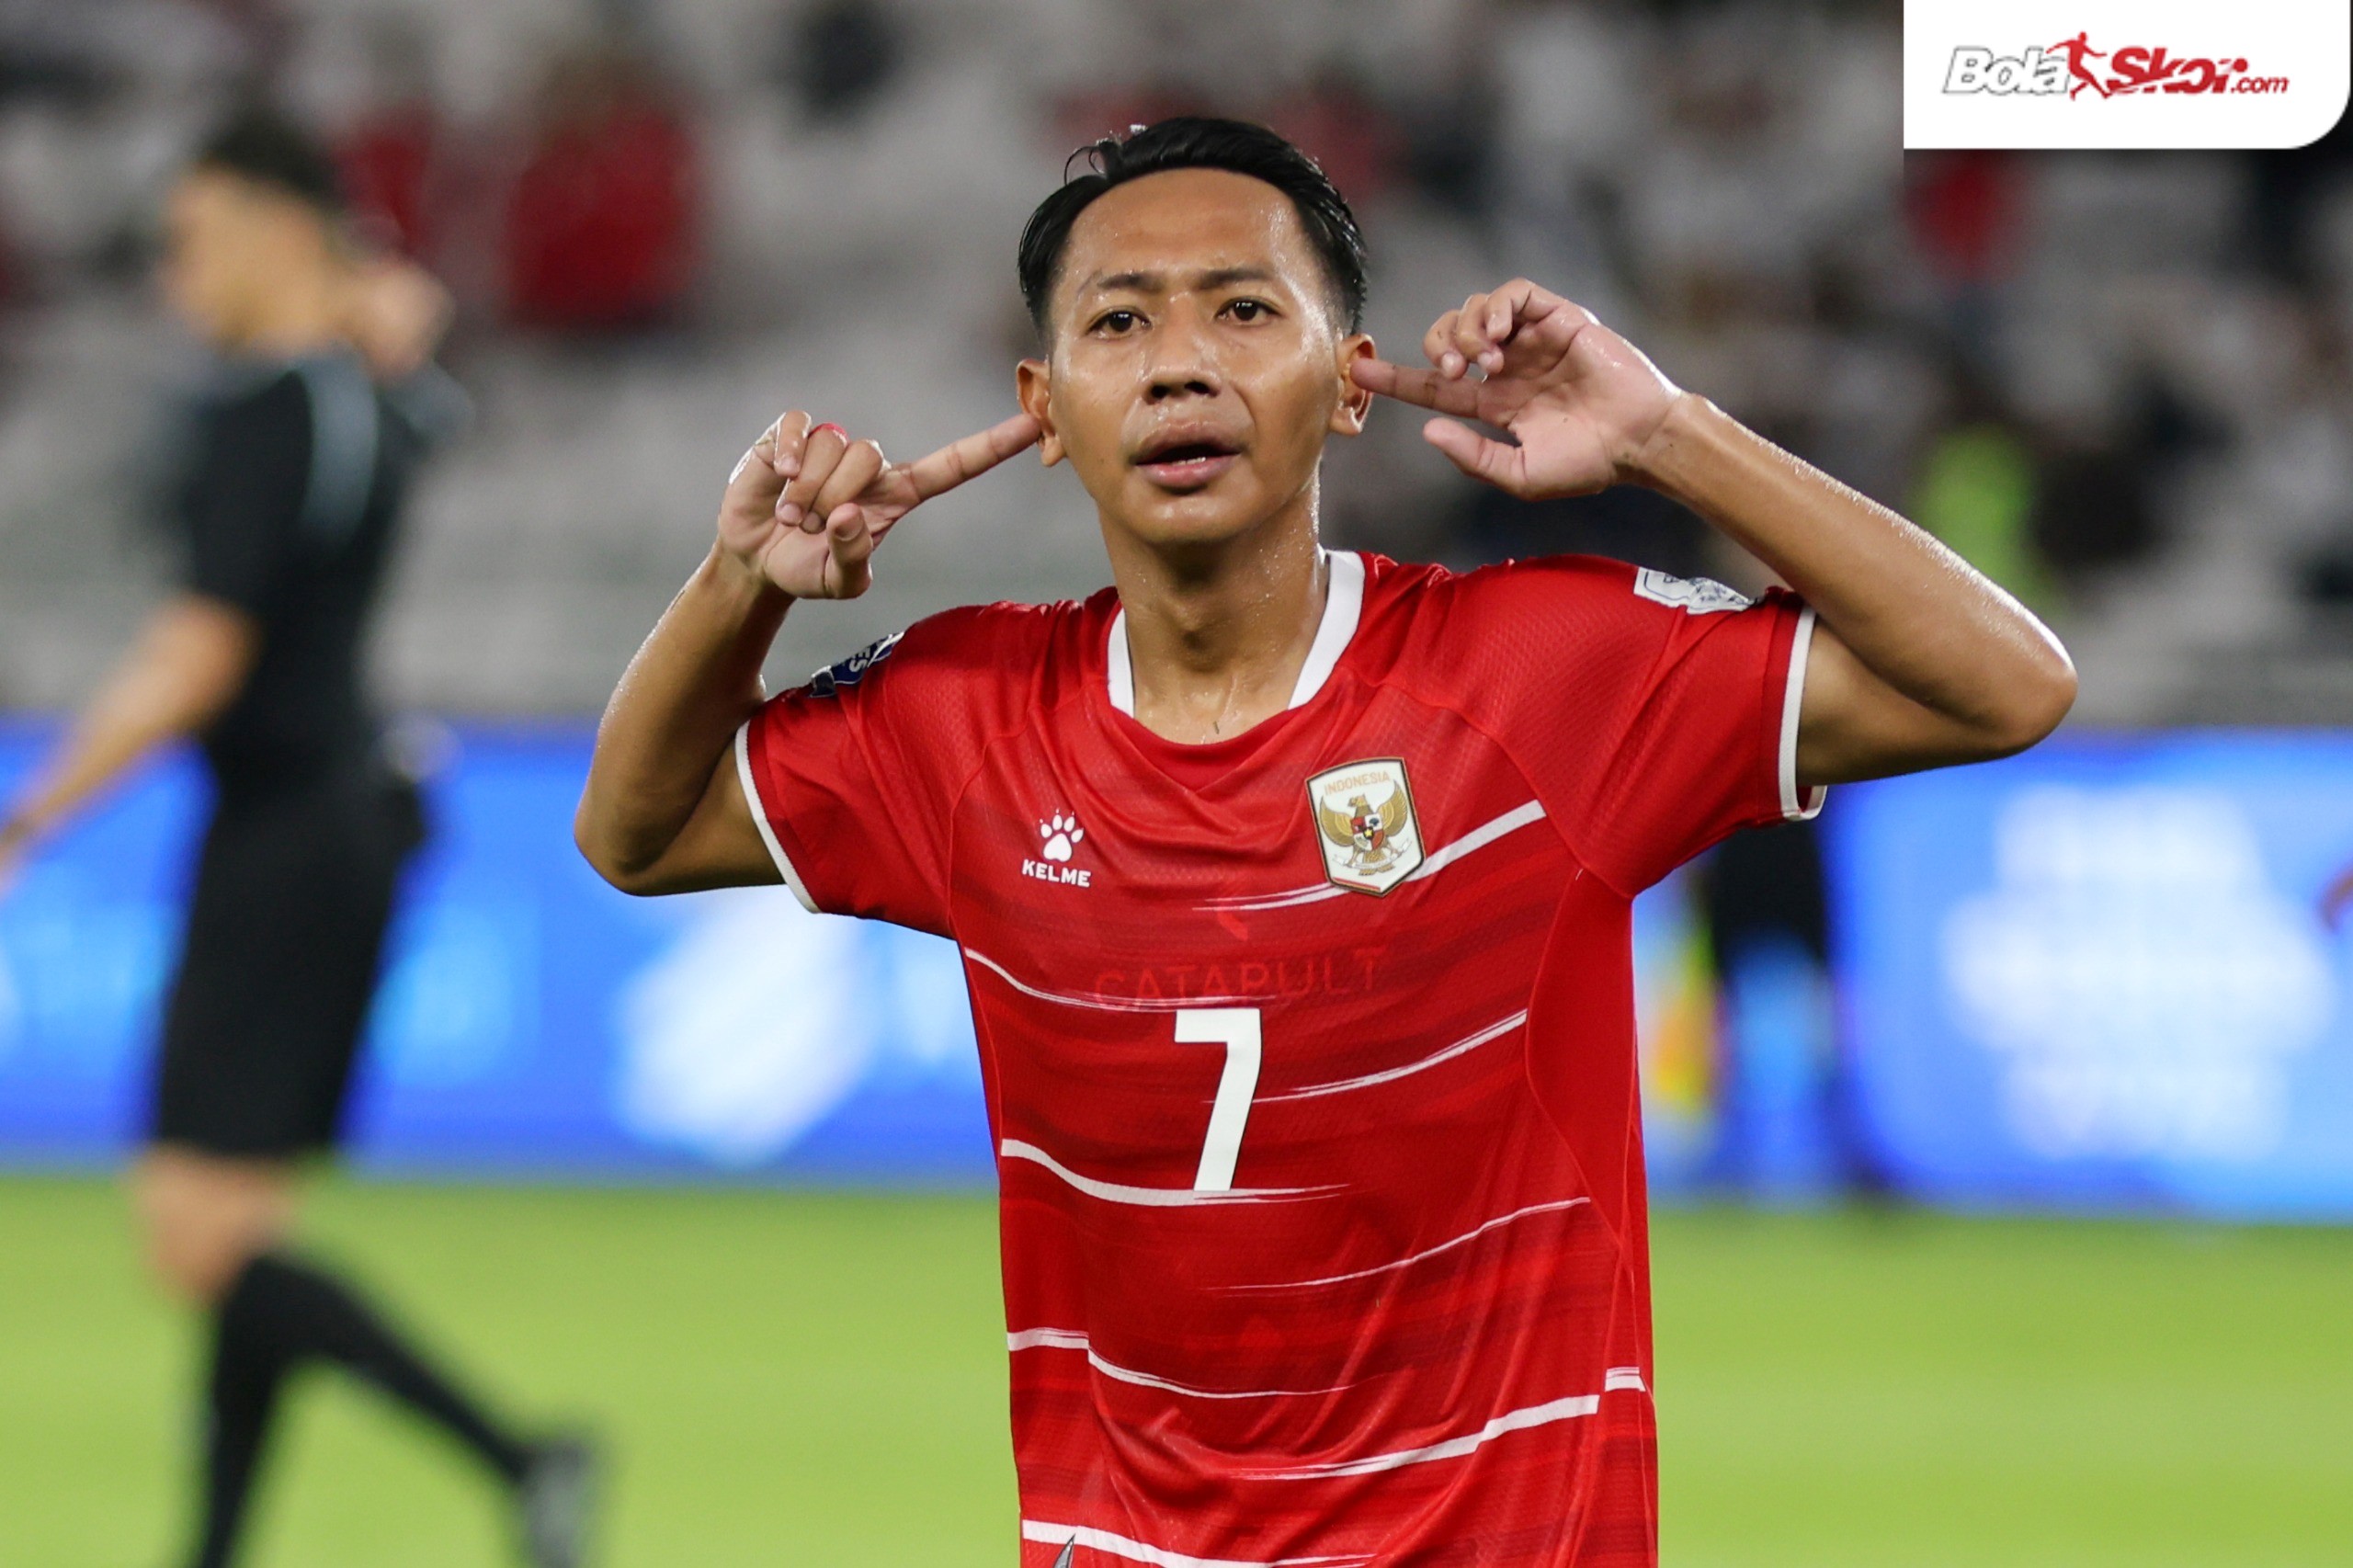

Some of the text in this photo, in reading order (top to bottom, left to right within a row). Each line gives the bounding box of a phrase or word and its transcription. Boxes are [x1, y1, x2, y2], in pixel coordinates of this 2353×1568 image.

[1324, 771, 1390, 794] INDONESIA
[1021, 858, 1092, 888] KELME
[1095, 946, 1386, 1007] CATAPULT
[1175, 1006, 1263, 1192] 7
